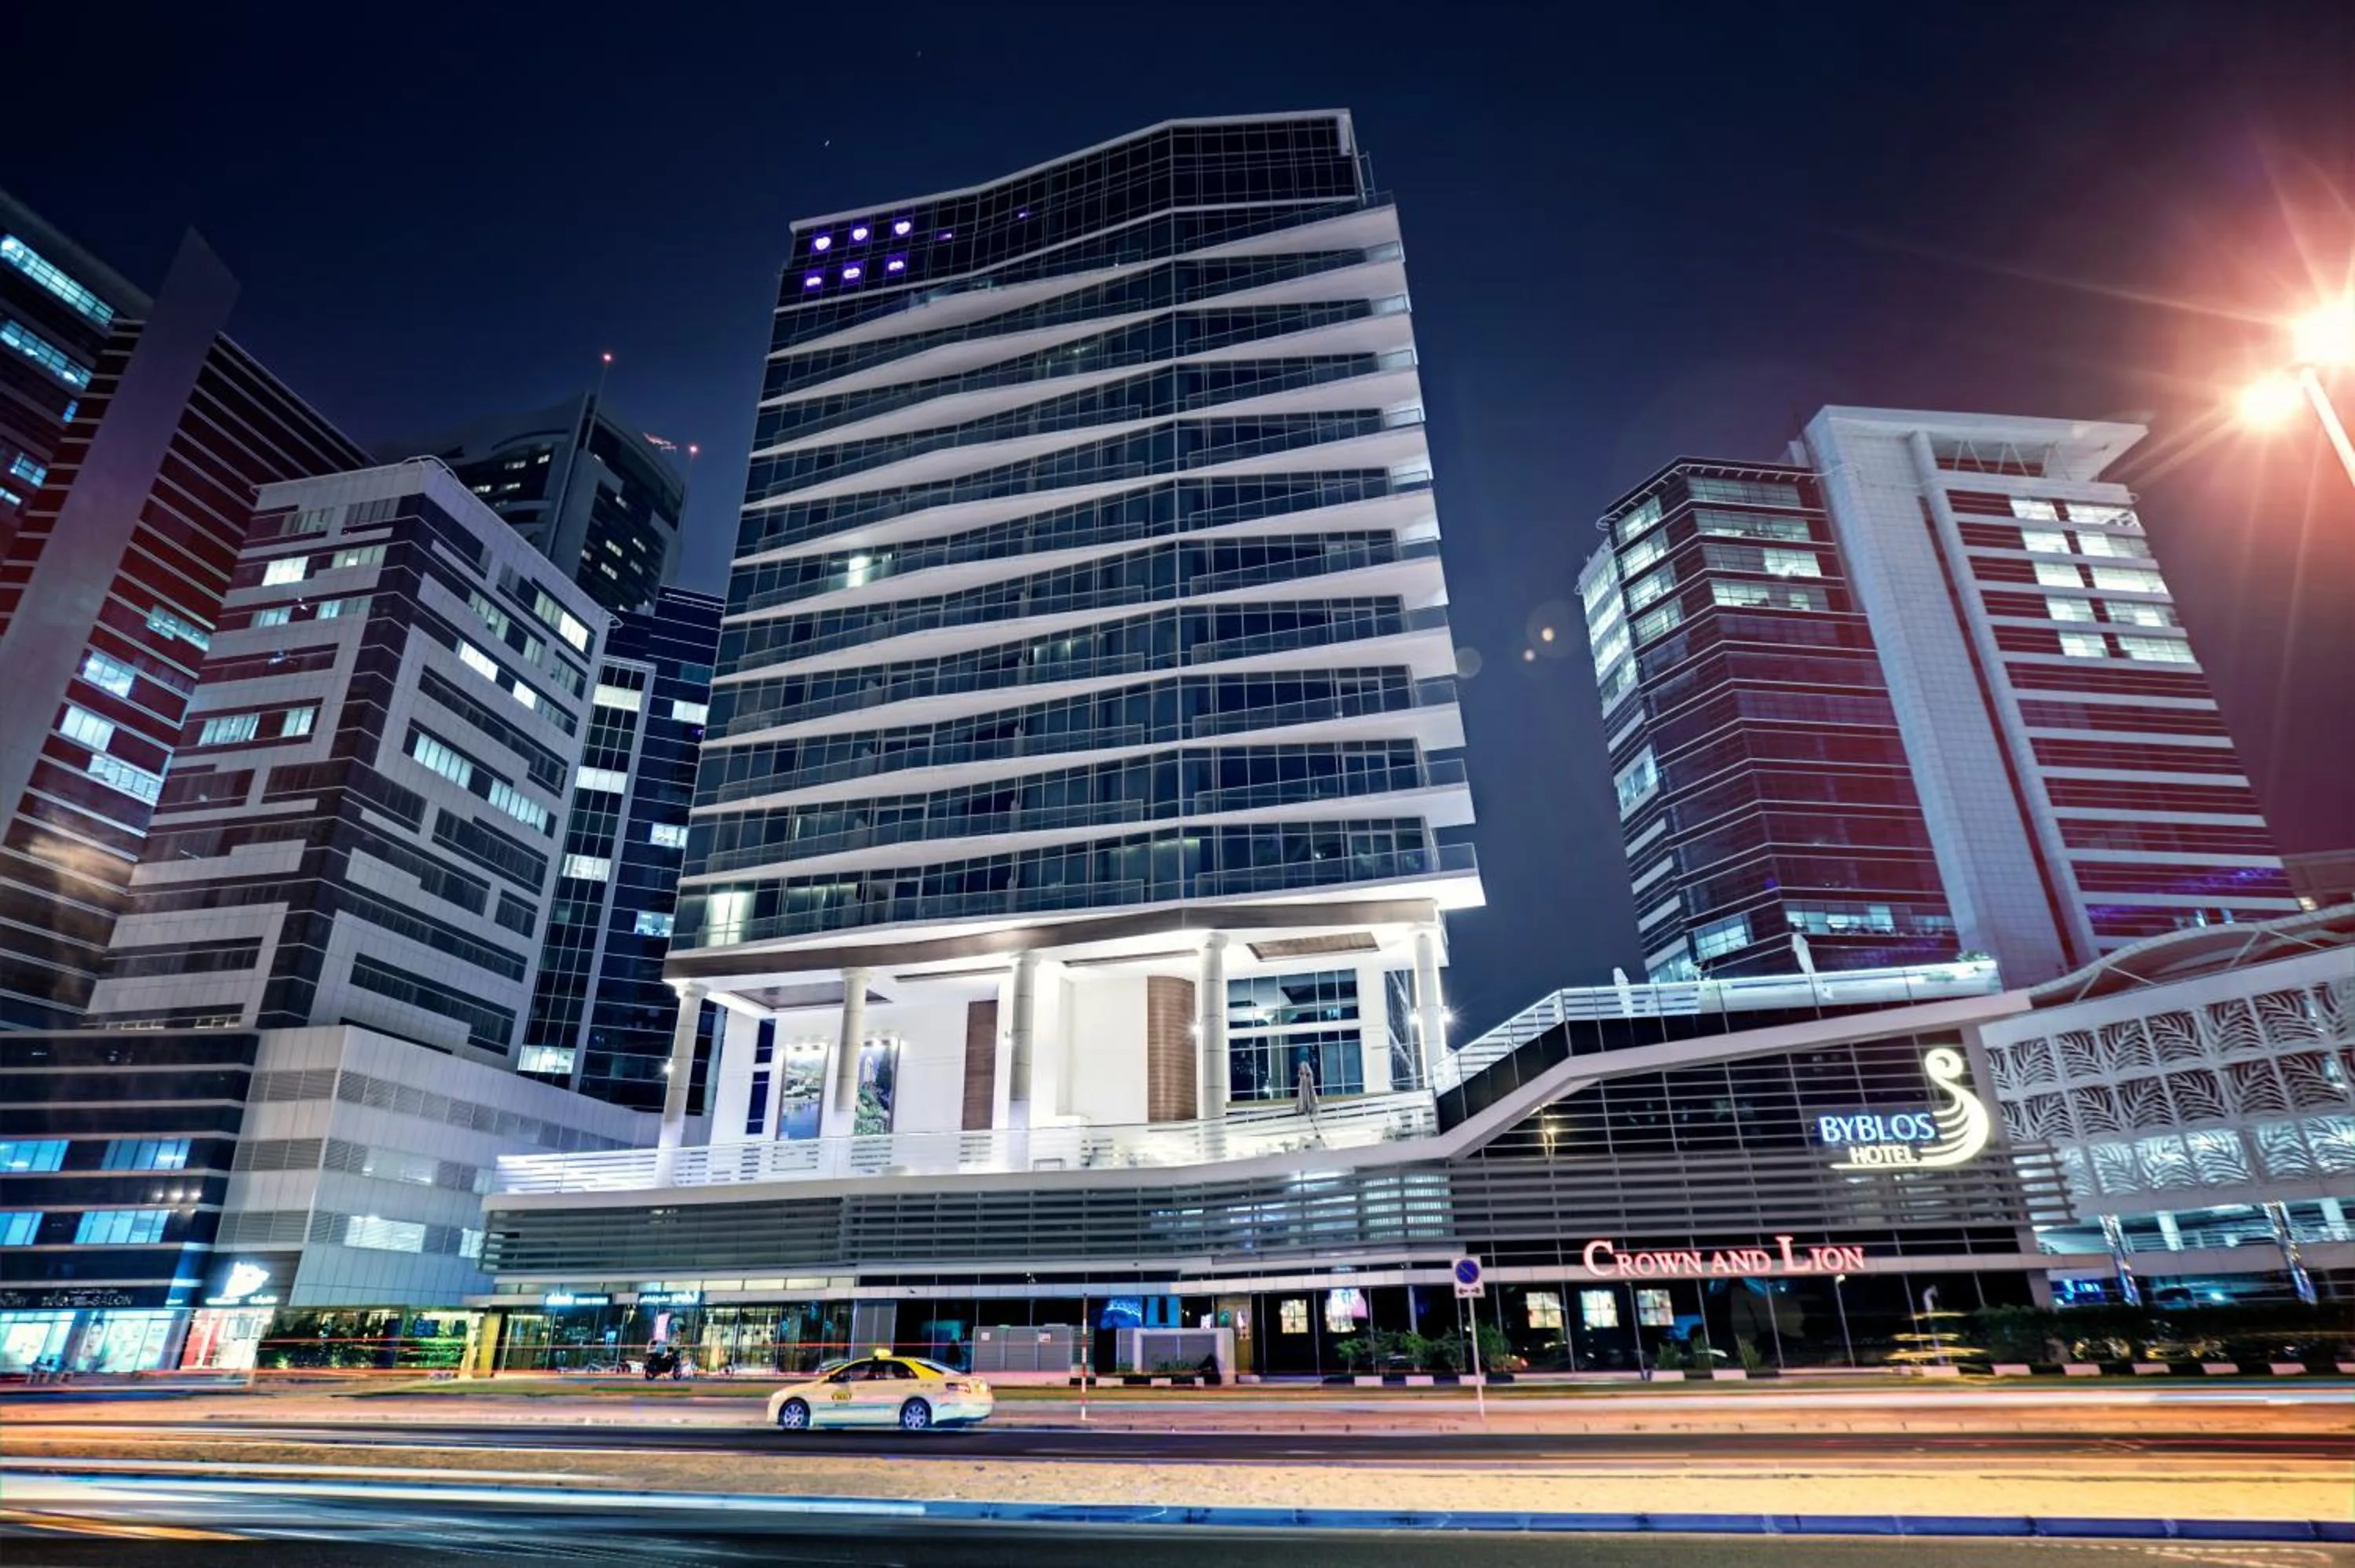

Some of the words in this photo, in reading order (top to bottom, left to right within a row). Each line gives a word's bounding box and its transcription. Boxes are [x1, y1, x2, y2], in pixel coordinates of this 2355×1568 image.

[1819, 1113, 1935, 1143] BYBLOS
[1849, 1145, 1917, 1164] HOTEL
[1583, 1240, 1703, 1277] CROWN
[1711, 1249, 1772, 1274] AND
[1775, 1235, 1864, 1273] LION
